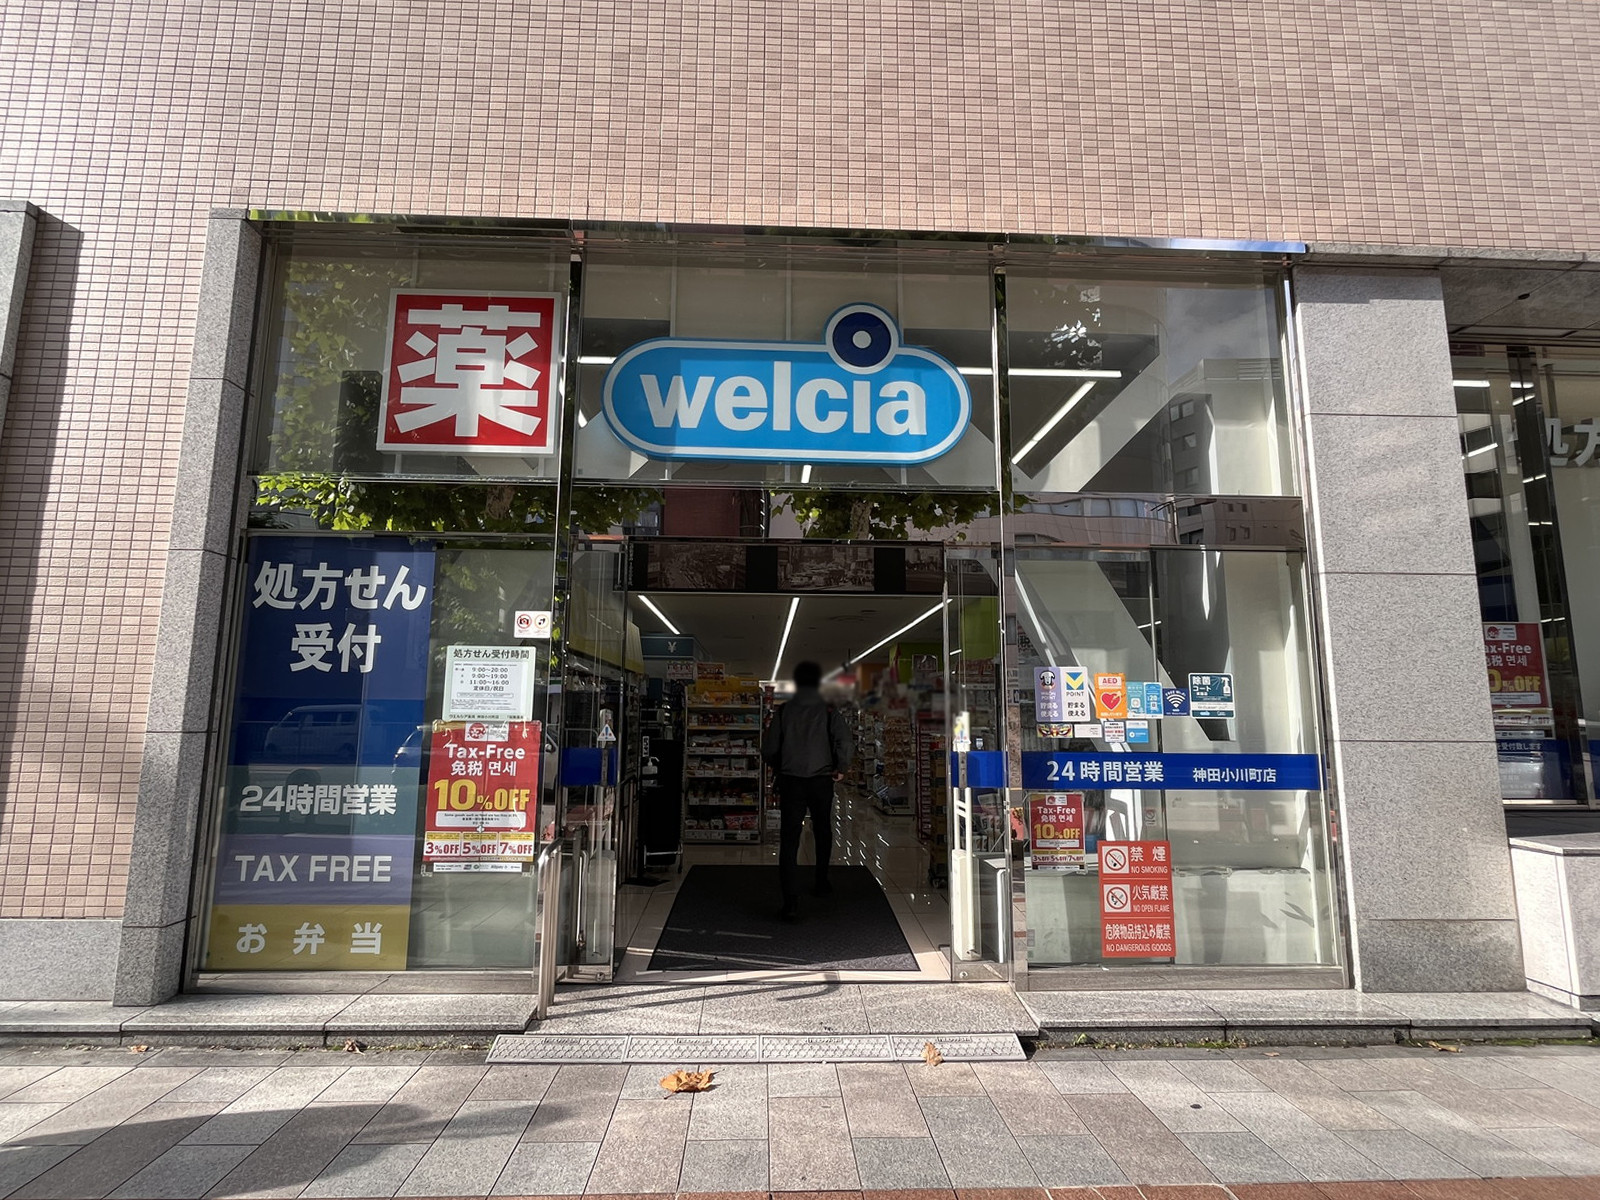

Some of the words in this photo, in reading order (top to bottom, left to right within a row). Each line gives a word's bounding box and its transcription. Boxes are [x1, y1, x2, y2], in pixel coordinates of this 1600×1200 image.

[394, 304, 542, 438] 薬
[639, 360, 928, 436] welcia
[252, 560, 428, 611] 処方せん
[289, 622, 382, 673] 受付
[453, 649, 530, 660] 処方せん受付時間
[1484, 643, 1532, 654] ax-Free
[446, 744, 525, 759] Tax-Free
[1498, 742, 1542, 750] 受付致します
[451, 760, 483, 776] 免税
[488, 761, 517, 776] 면세
[1192, 768, 1277, 783] 神田小川町店
[240, 784, 398, 815] 24時間営業
[235, 855, 299, 882] TAX
[309, 855, 393, 882] FREE
[1131, 866, 1139, 874] NO
[1141, 866, 1168, 874] SMOKING
[1132, 884, 1169, 900] 火気厳禁
[1105, 923, 1171, 940] 危険物品持込み厳禁
[1106, 944, 1114, 952] NO
[1116, 944, 1150, 952] DANGEROUS
[1151, 944, 1172, 952] GOODS
